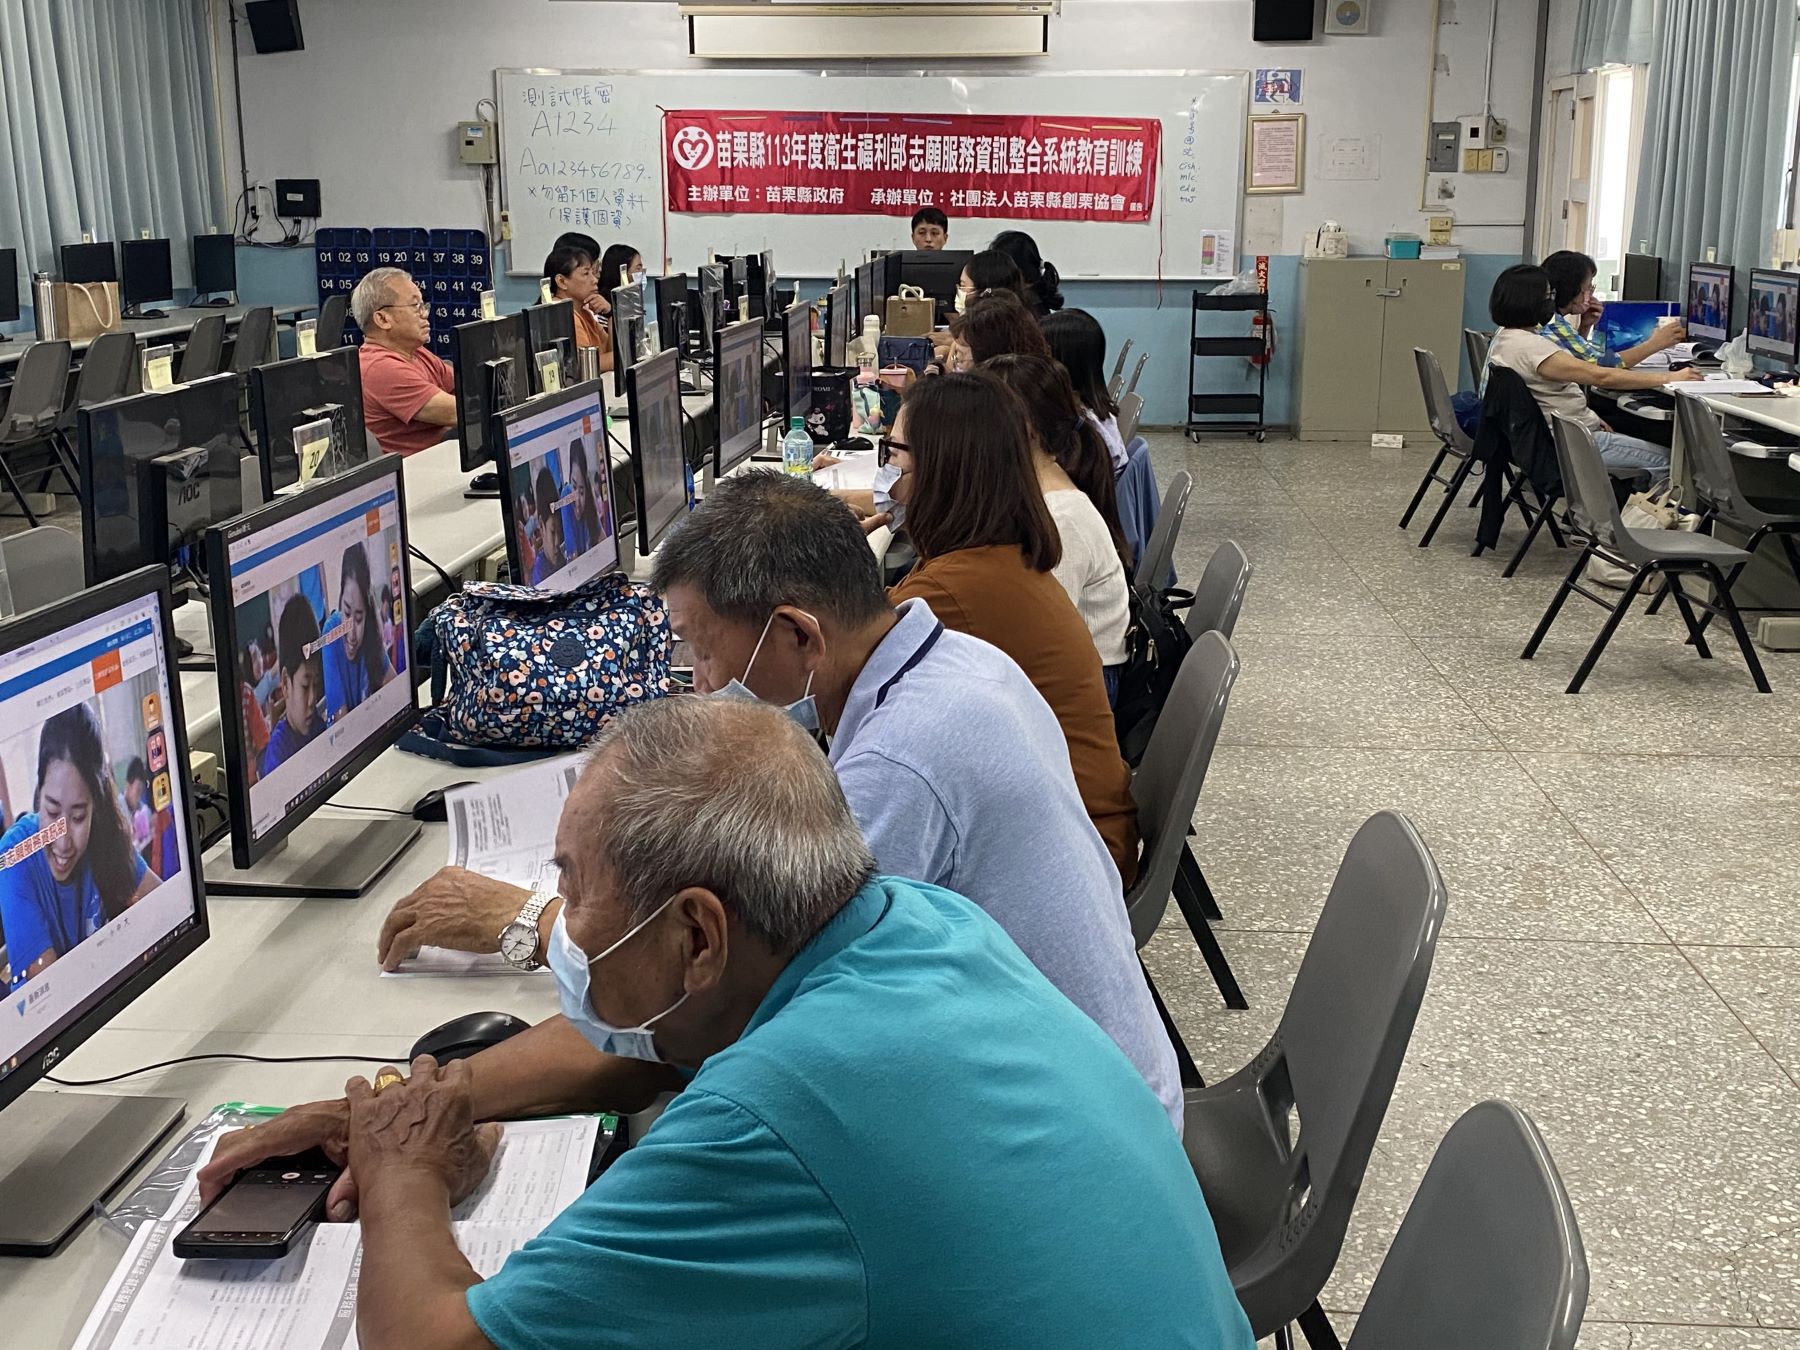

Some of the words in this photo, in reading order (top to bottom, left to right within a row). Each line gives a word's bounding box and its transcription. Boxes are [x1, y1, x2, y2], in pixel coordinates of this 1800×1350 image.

[531, 110, 618, 136] A1234
[716, 130, 1144, 177] 苗栗縣113年度衛生福利部志願服務資訊整合系統教育訓練
[320, 253, 332, 262] 01
[338, 253, 351, 262] 02
[356, 253, 369, 263] 03
[378, 253, 390, 262] 19
[394, 252, 407, 262] 20
[414, 252, 425, 262] 21
[433, 252, 445, 262] 37
[452, 253, 465, 263] 38
[470, 255, 483, 265] 39
[321, 279, 333, 289] 04
[338, 279, 352, 289] 05
[434, 282, 447, 291] 40
[452, 281, 464, 291] 41
[470, 281, 483, 291] 42
[436, 308, 448, 317] 43
[452, 308, 465, 317] 44
[471, 308, 483, 317] 45
[342, 334, 354, 343] 11
[437, 334, 450, 344] 46
[309, 449, 320, 470] 20
[178, 482, 200, 506] AOC
[42, 1047, 60, 1070] AOC
